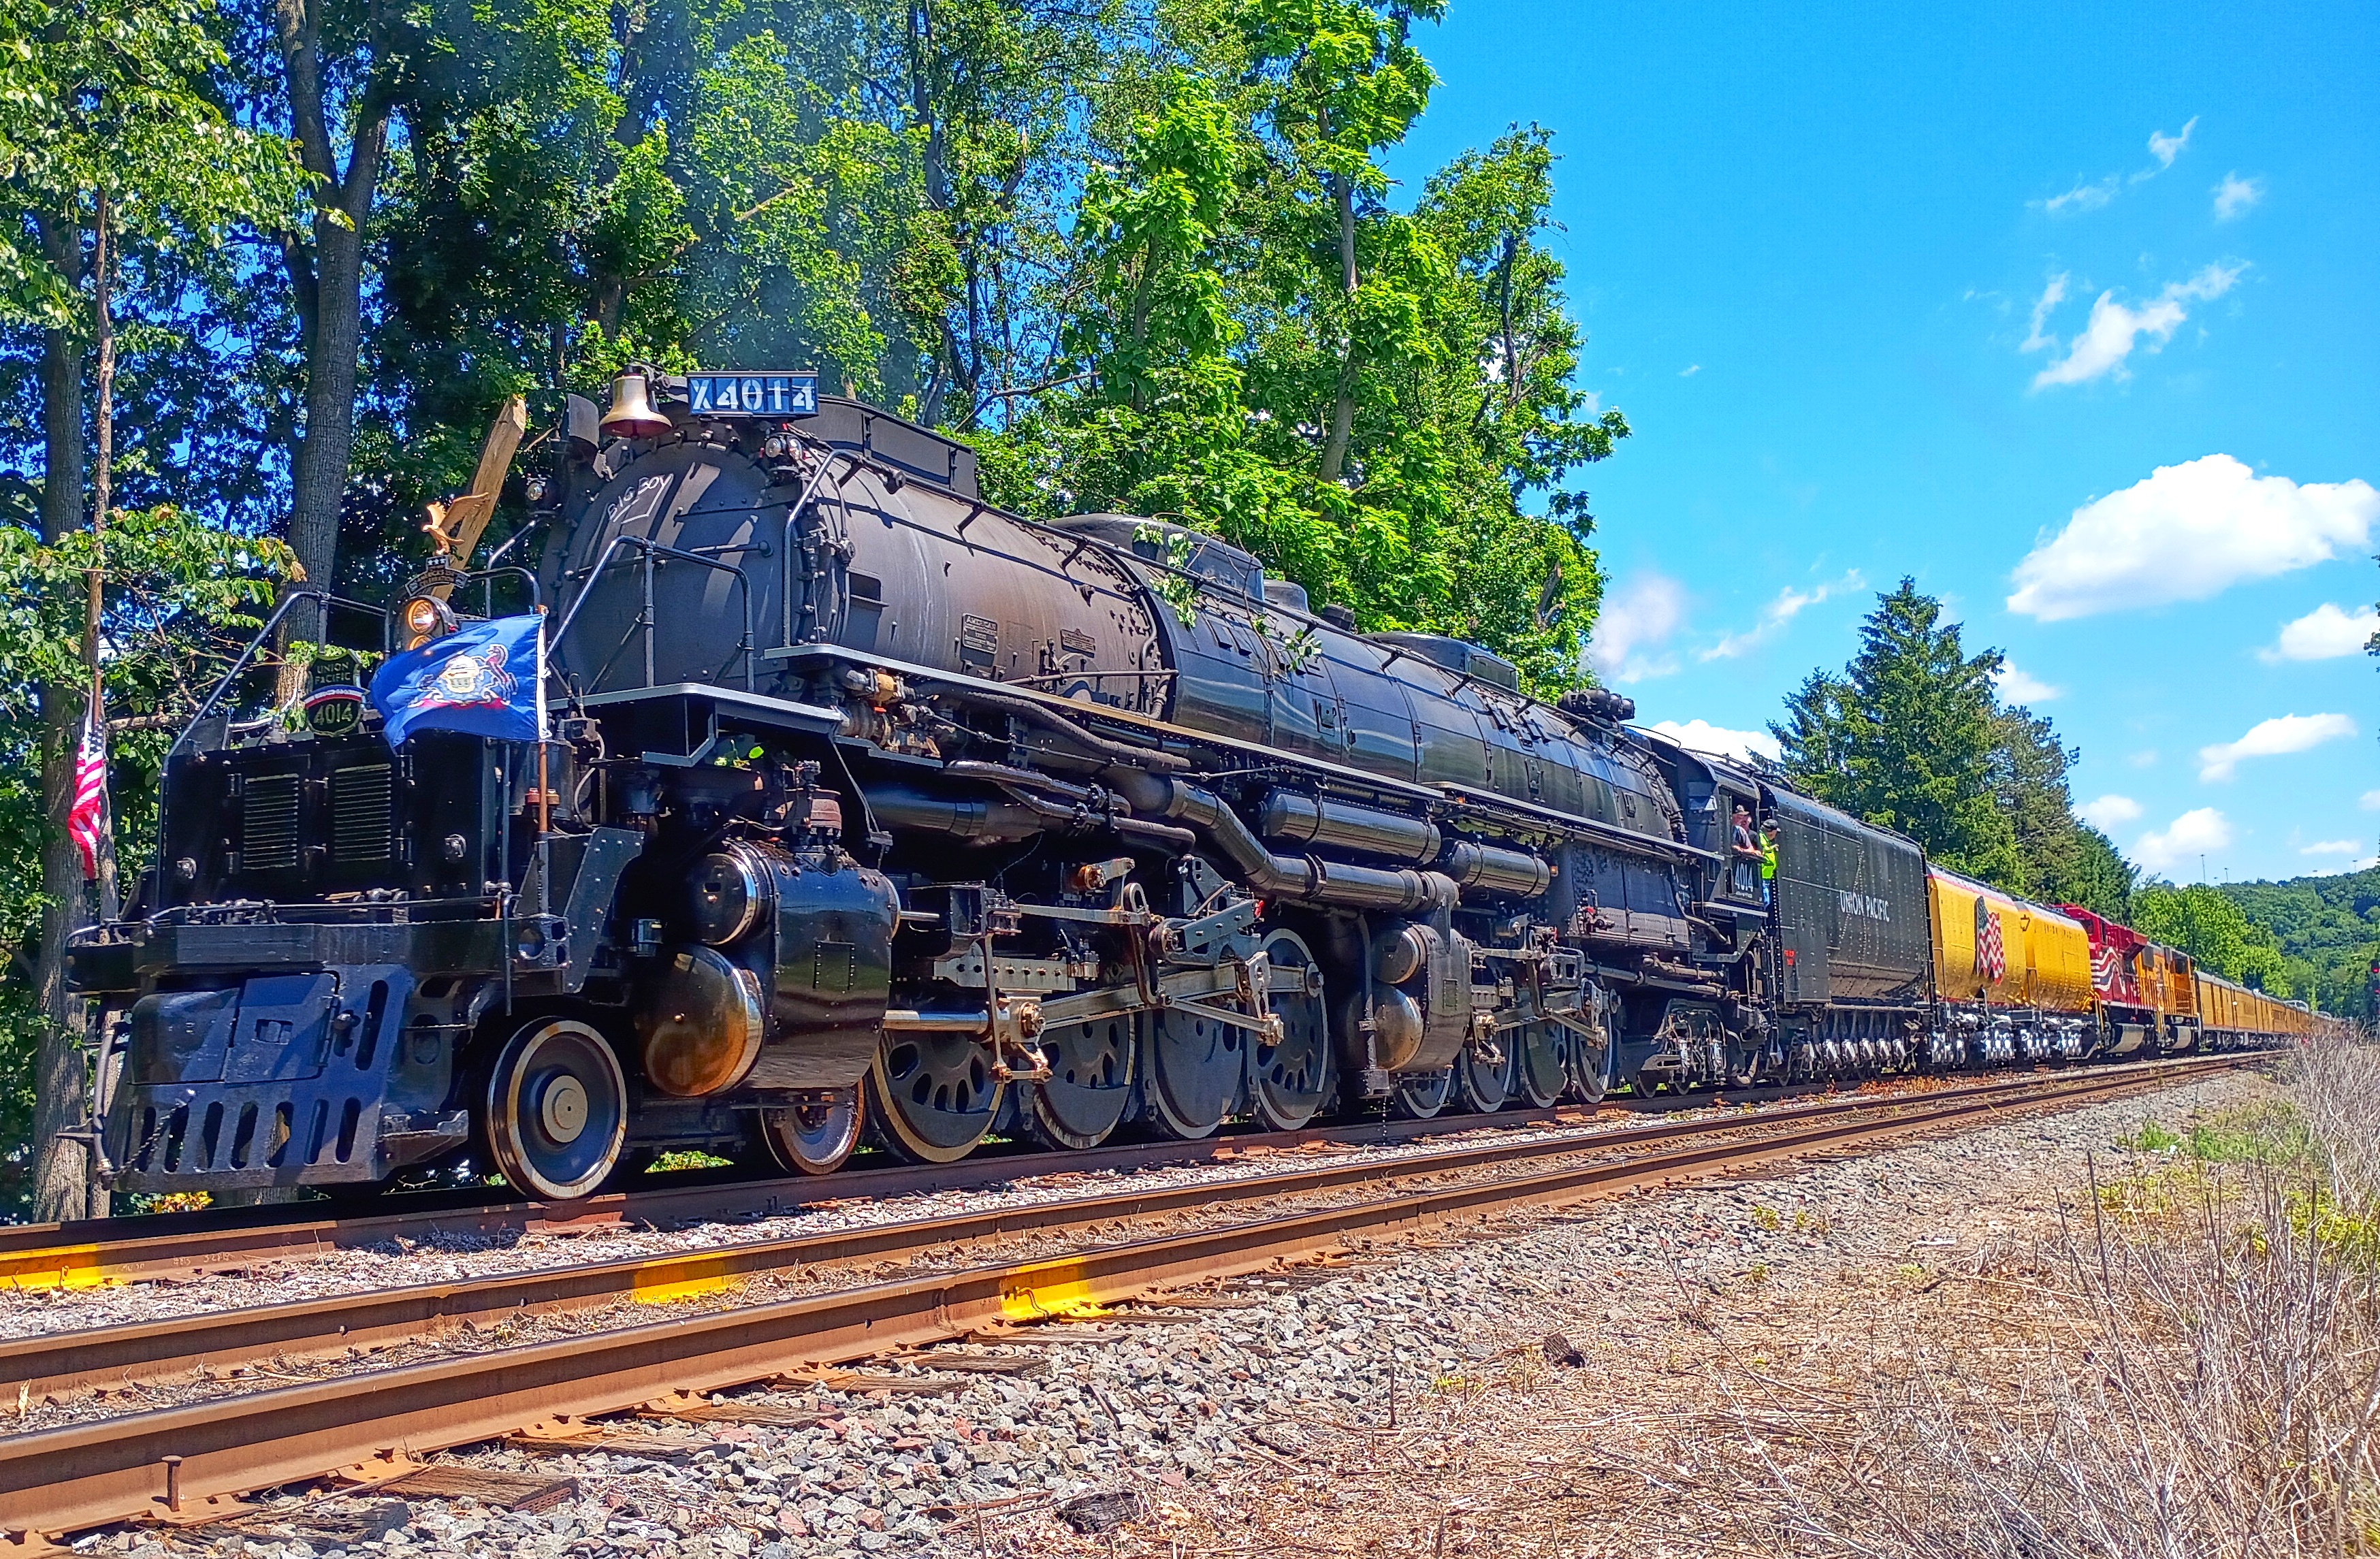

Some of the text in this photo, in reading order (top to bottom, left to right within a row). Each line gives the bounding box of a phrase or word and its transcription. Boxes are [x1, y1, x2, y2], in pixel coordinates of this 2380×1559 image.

[690, 379, 815, 411] X4014
[637, 473, 674, 500] BOY
[315, 672, 351, 685] PACIFIC
[317, 662, 349, 674] UNION
[313, 702, 353, 725] 4014
[1735, 861, 1754, 892] 4014
[1839, 890, 1890, 922] UNION PACIFIC
